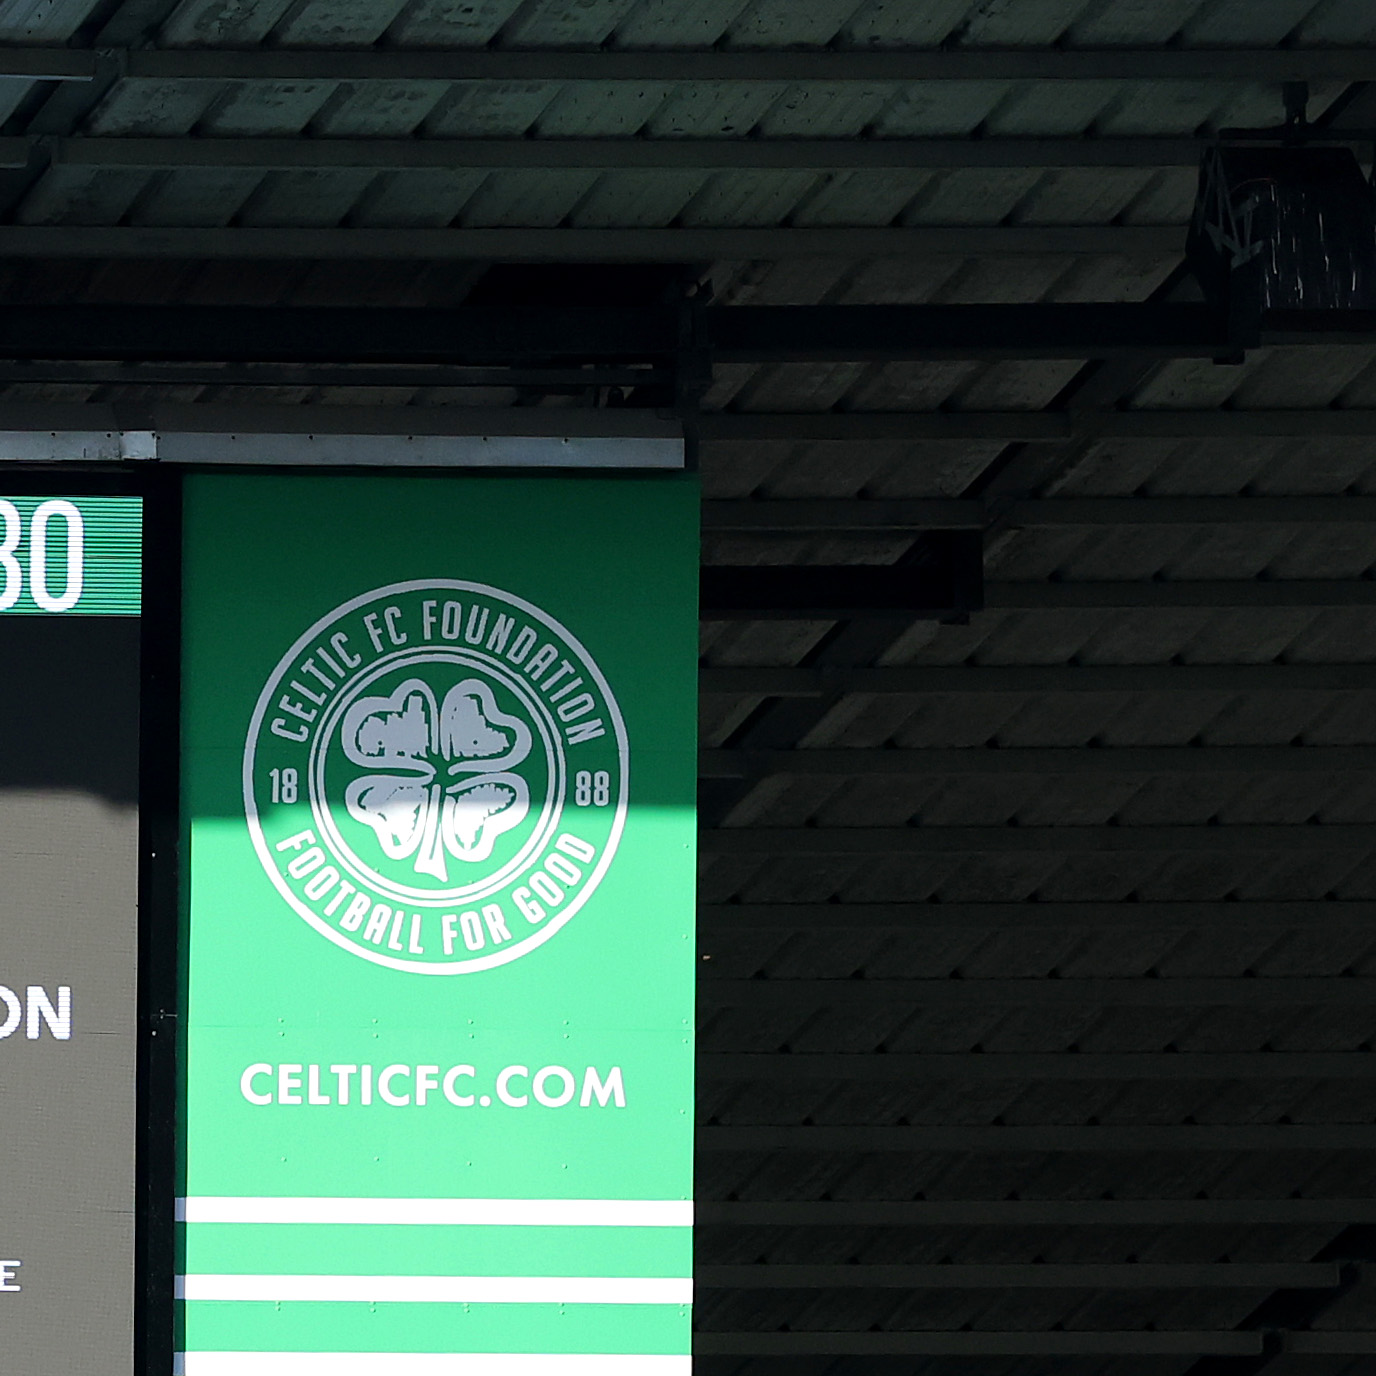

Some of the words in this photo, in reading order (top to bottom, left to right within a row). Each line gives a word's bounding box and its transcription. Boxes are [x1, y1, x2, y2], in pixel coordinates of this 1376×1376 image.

[270, 631, 364, 744] CELTIC
[363, 605, 409, 653] FC
[422, 600, 606, 746] FOUNDATION
[269, 767, 299, 805] 18
[575, 770, 610, 807] 88
[276, 828, 424, 955] FOOTBALL
[441, 905, 513, 956] FOR
[512, 832, 596, 925] GOOD
[239, 1062, 627, 1108] CELTICFC.COM
